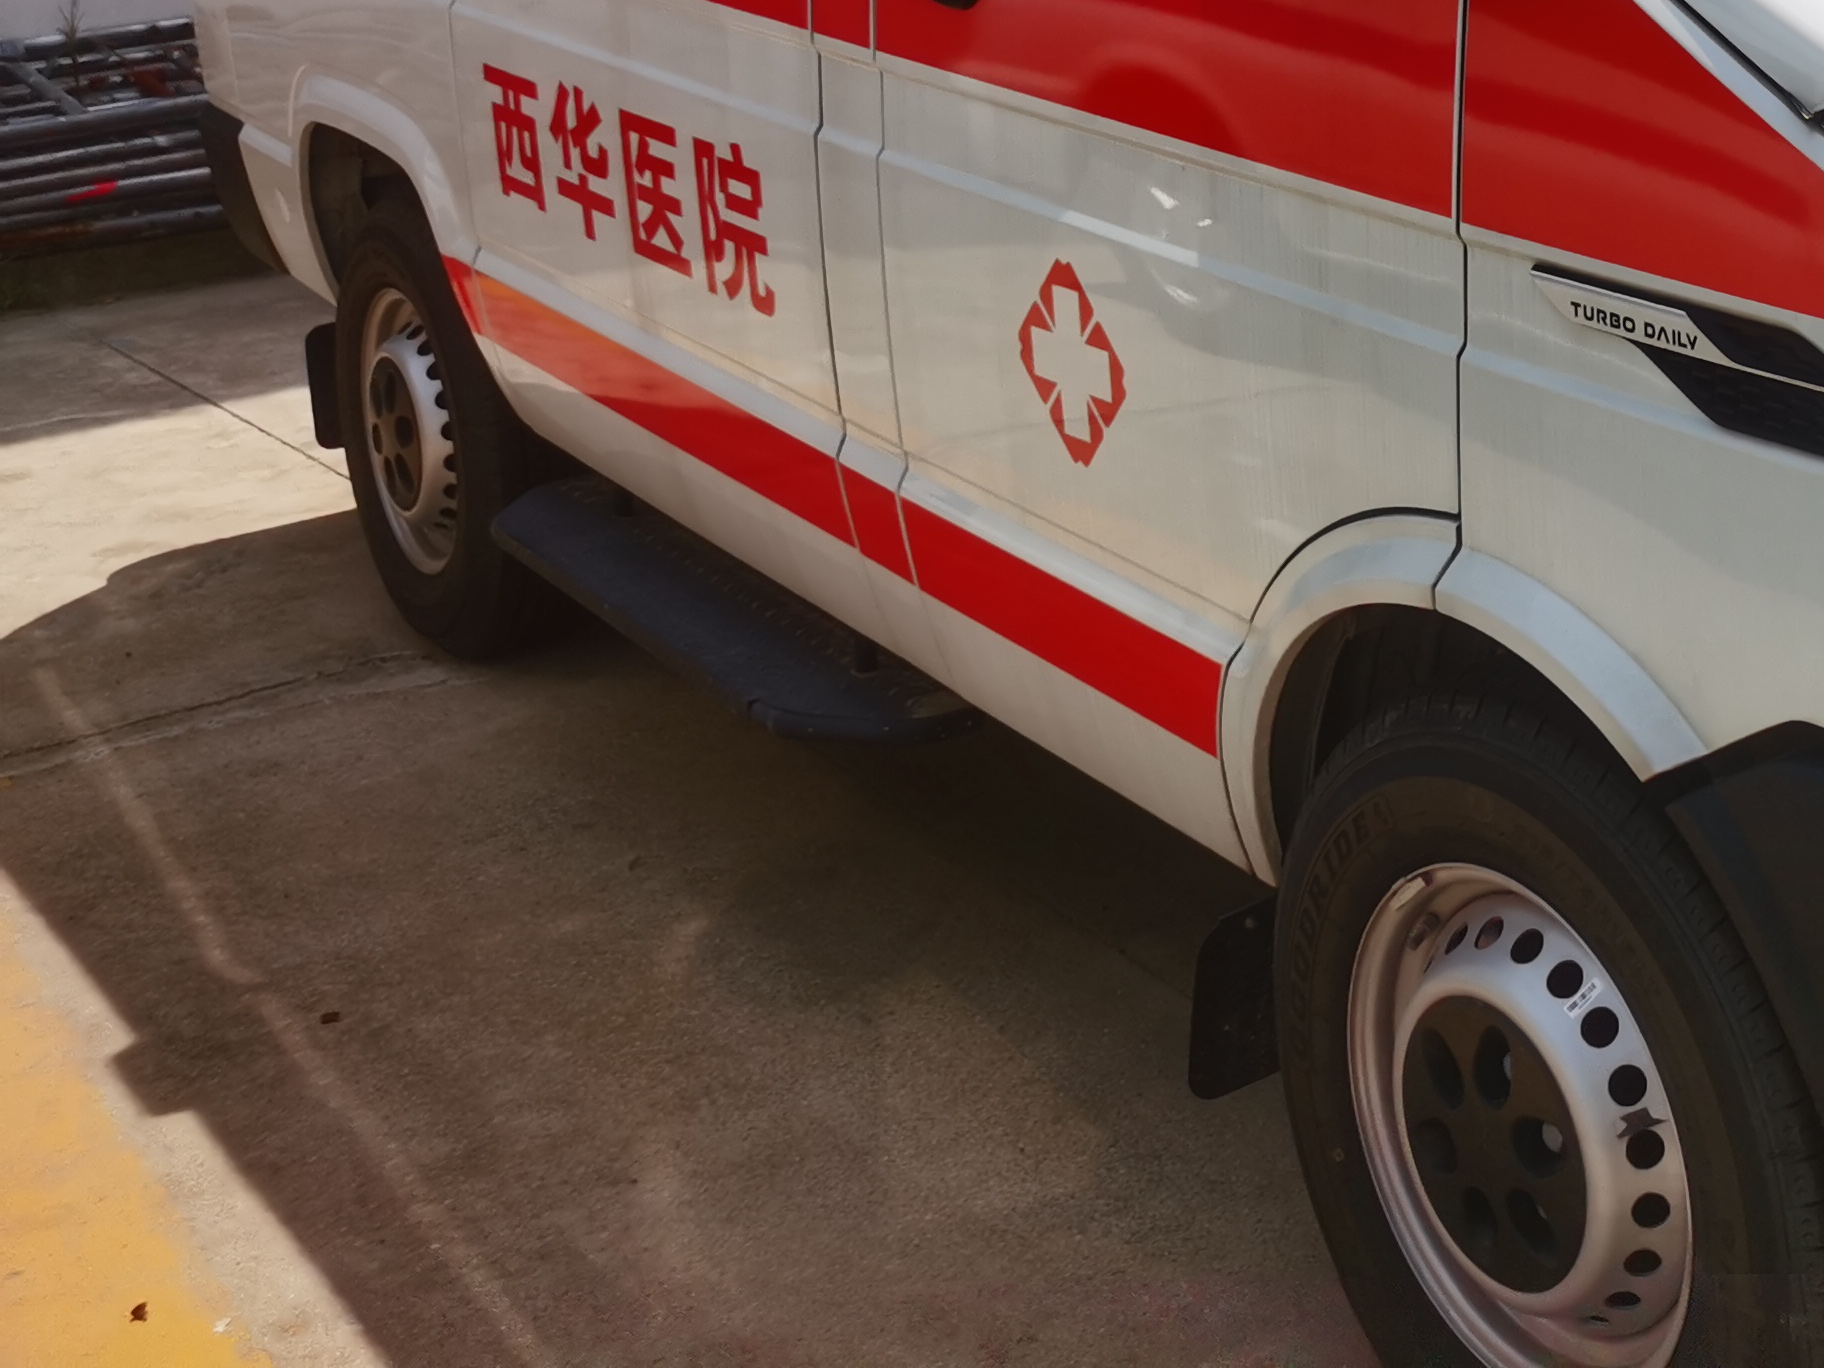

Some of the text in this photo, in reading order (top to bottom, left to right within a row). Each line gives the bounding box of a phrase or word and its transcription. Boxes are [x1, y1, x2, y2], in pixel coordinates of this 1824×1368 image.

[483, 62, 776, 318] 西华医院
[1570, 301, 1698, 350] TURBO DAILY
